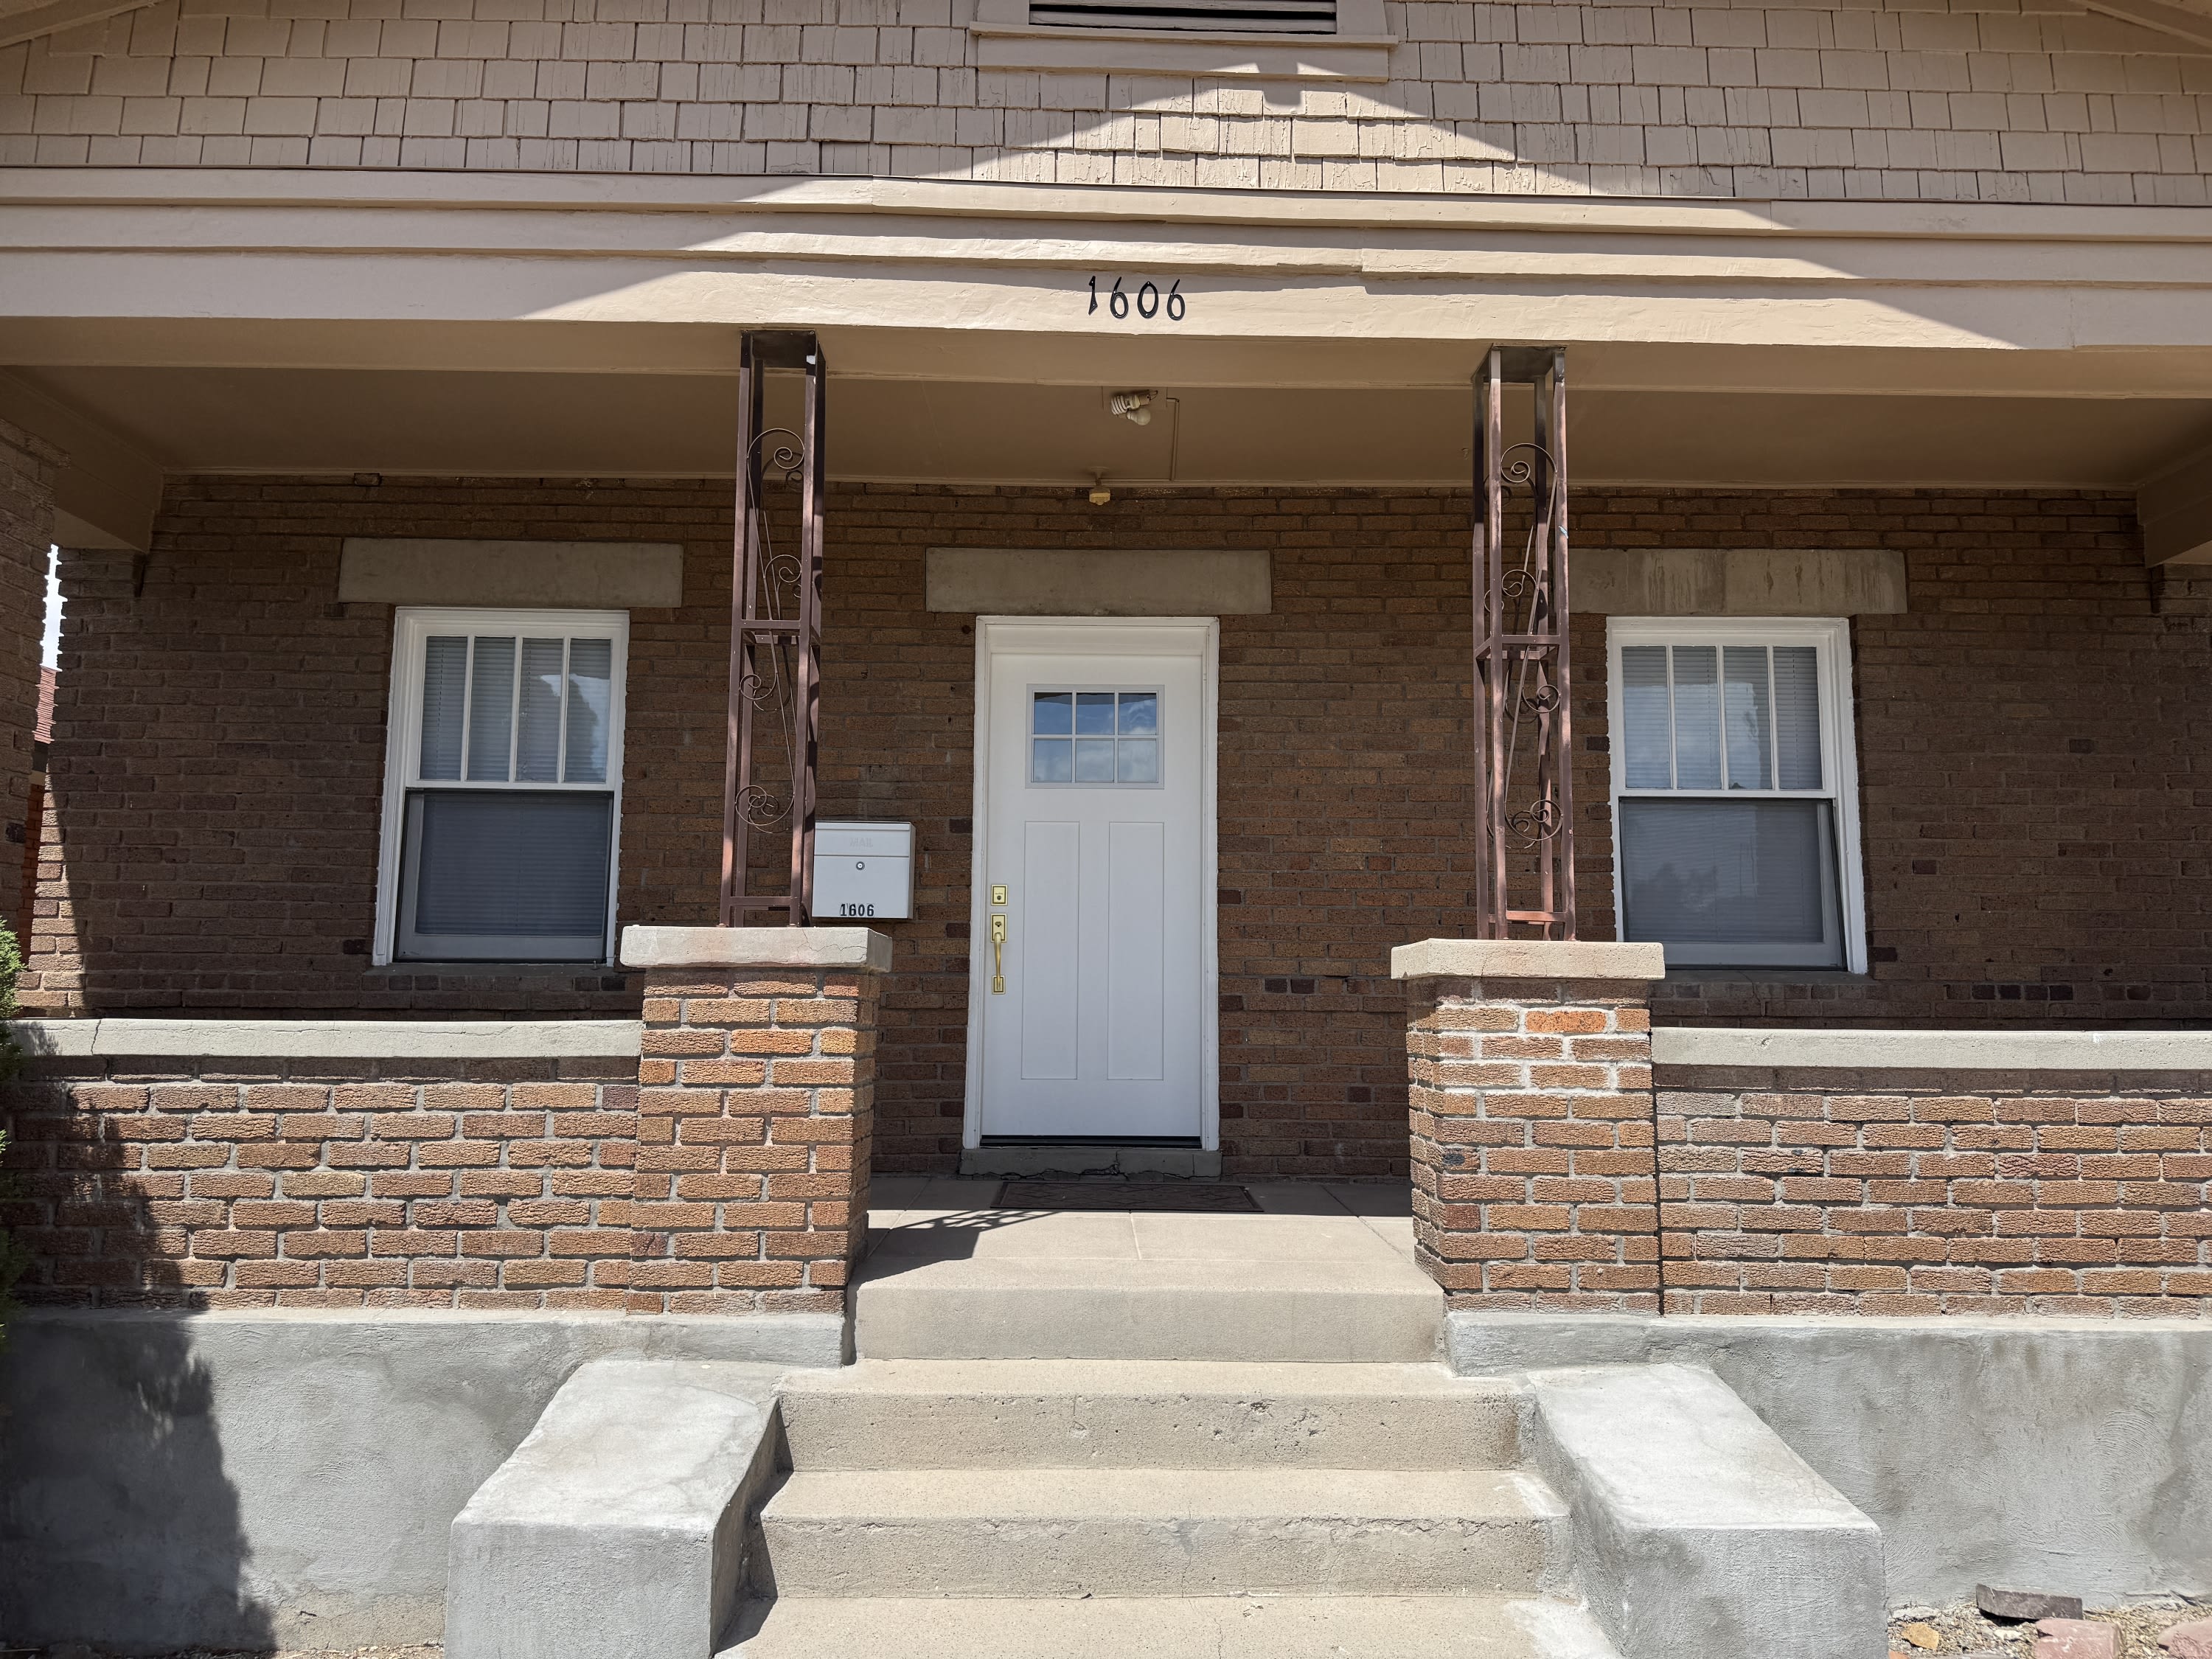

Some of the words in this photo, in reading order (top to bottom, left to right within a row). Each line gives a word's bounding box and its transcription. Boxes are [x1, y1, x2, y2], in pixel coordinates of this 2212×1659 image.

[1088, 275, 1186, 321] 1606
[849, 837, 874, 847] MAIL
[840, 903, 874, 917] 1606
